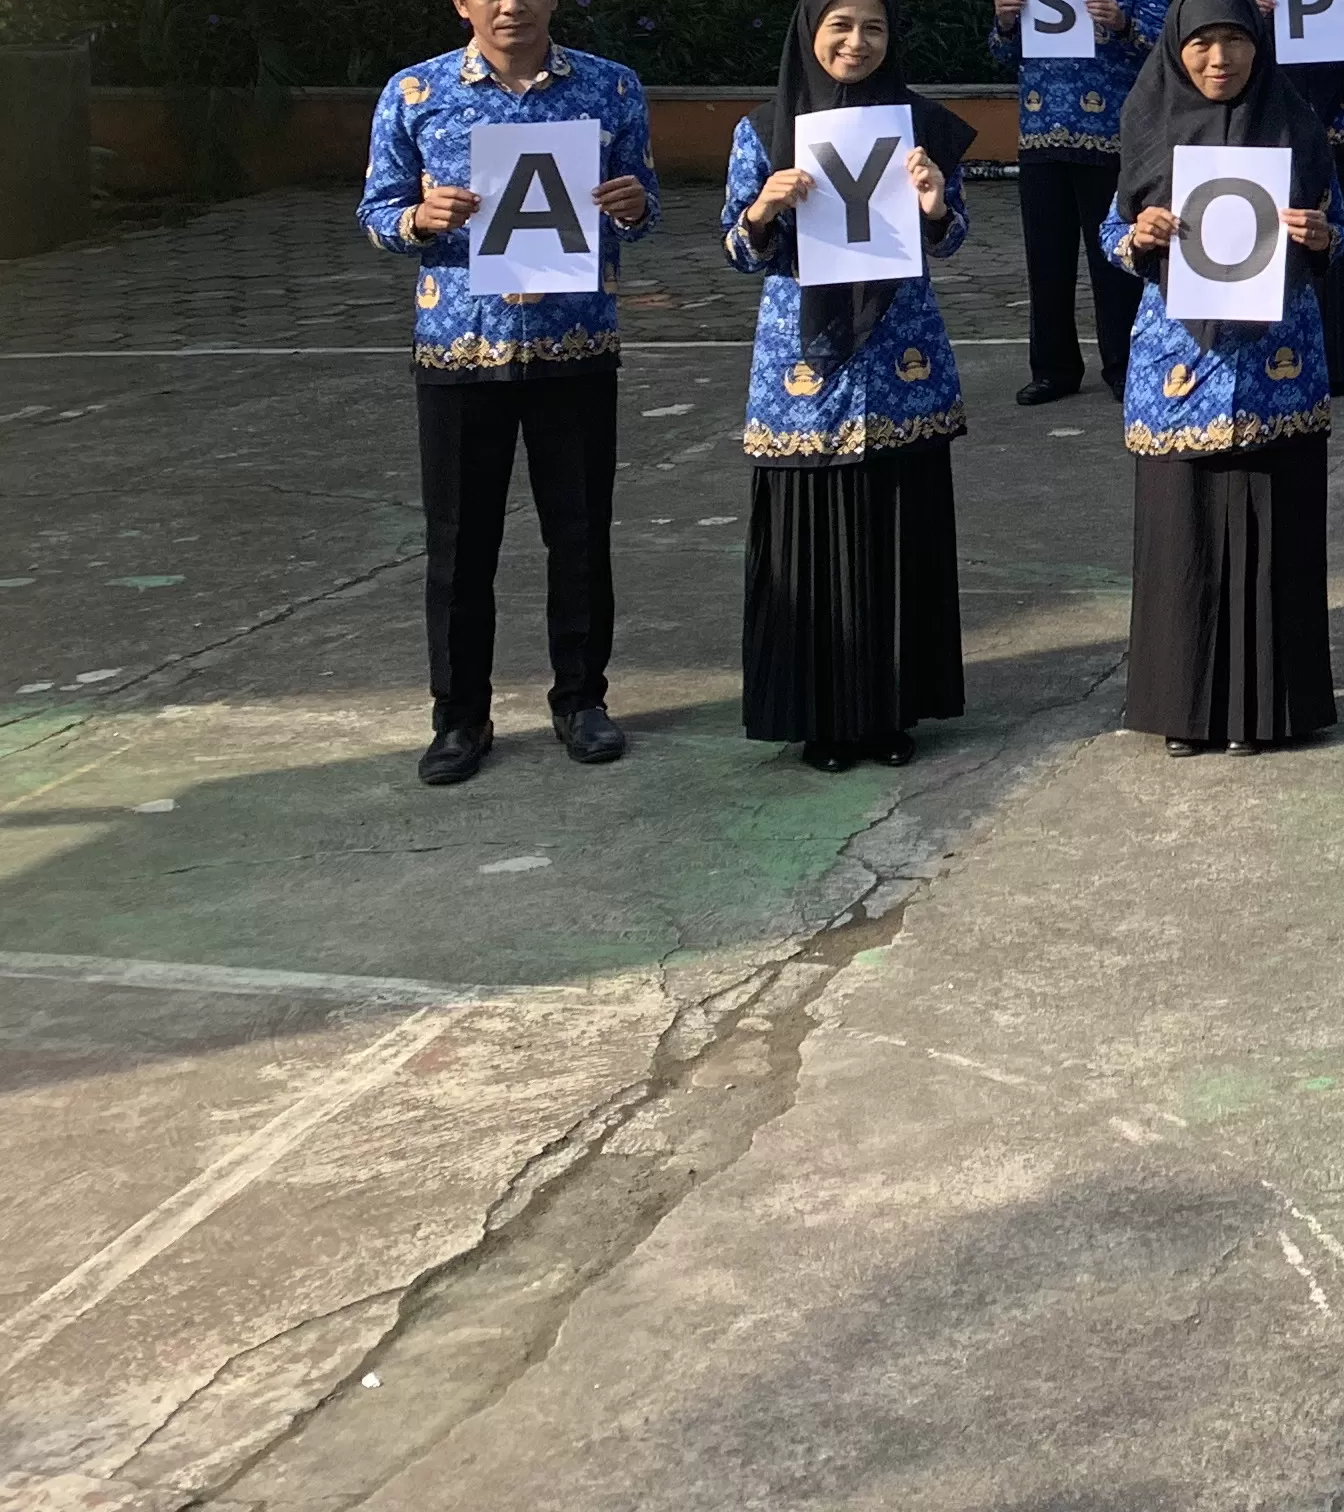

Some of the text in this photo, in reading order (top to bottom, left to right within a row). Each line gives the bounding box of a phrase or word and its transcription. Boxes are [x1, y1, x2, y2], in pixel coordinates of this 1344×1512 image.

[478, 153, 590, 255] A
[808, 136, 902, 243] Y
[1179, 177, 1279, 282] O
